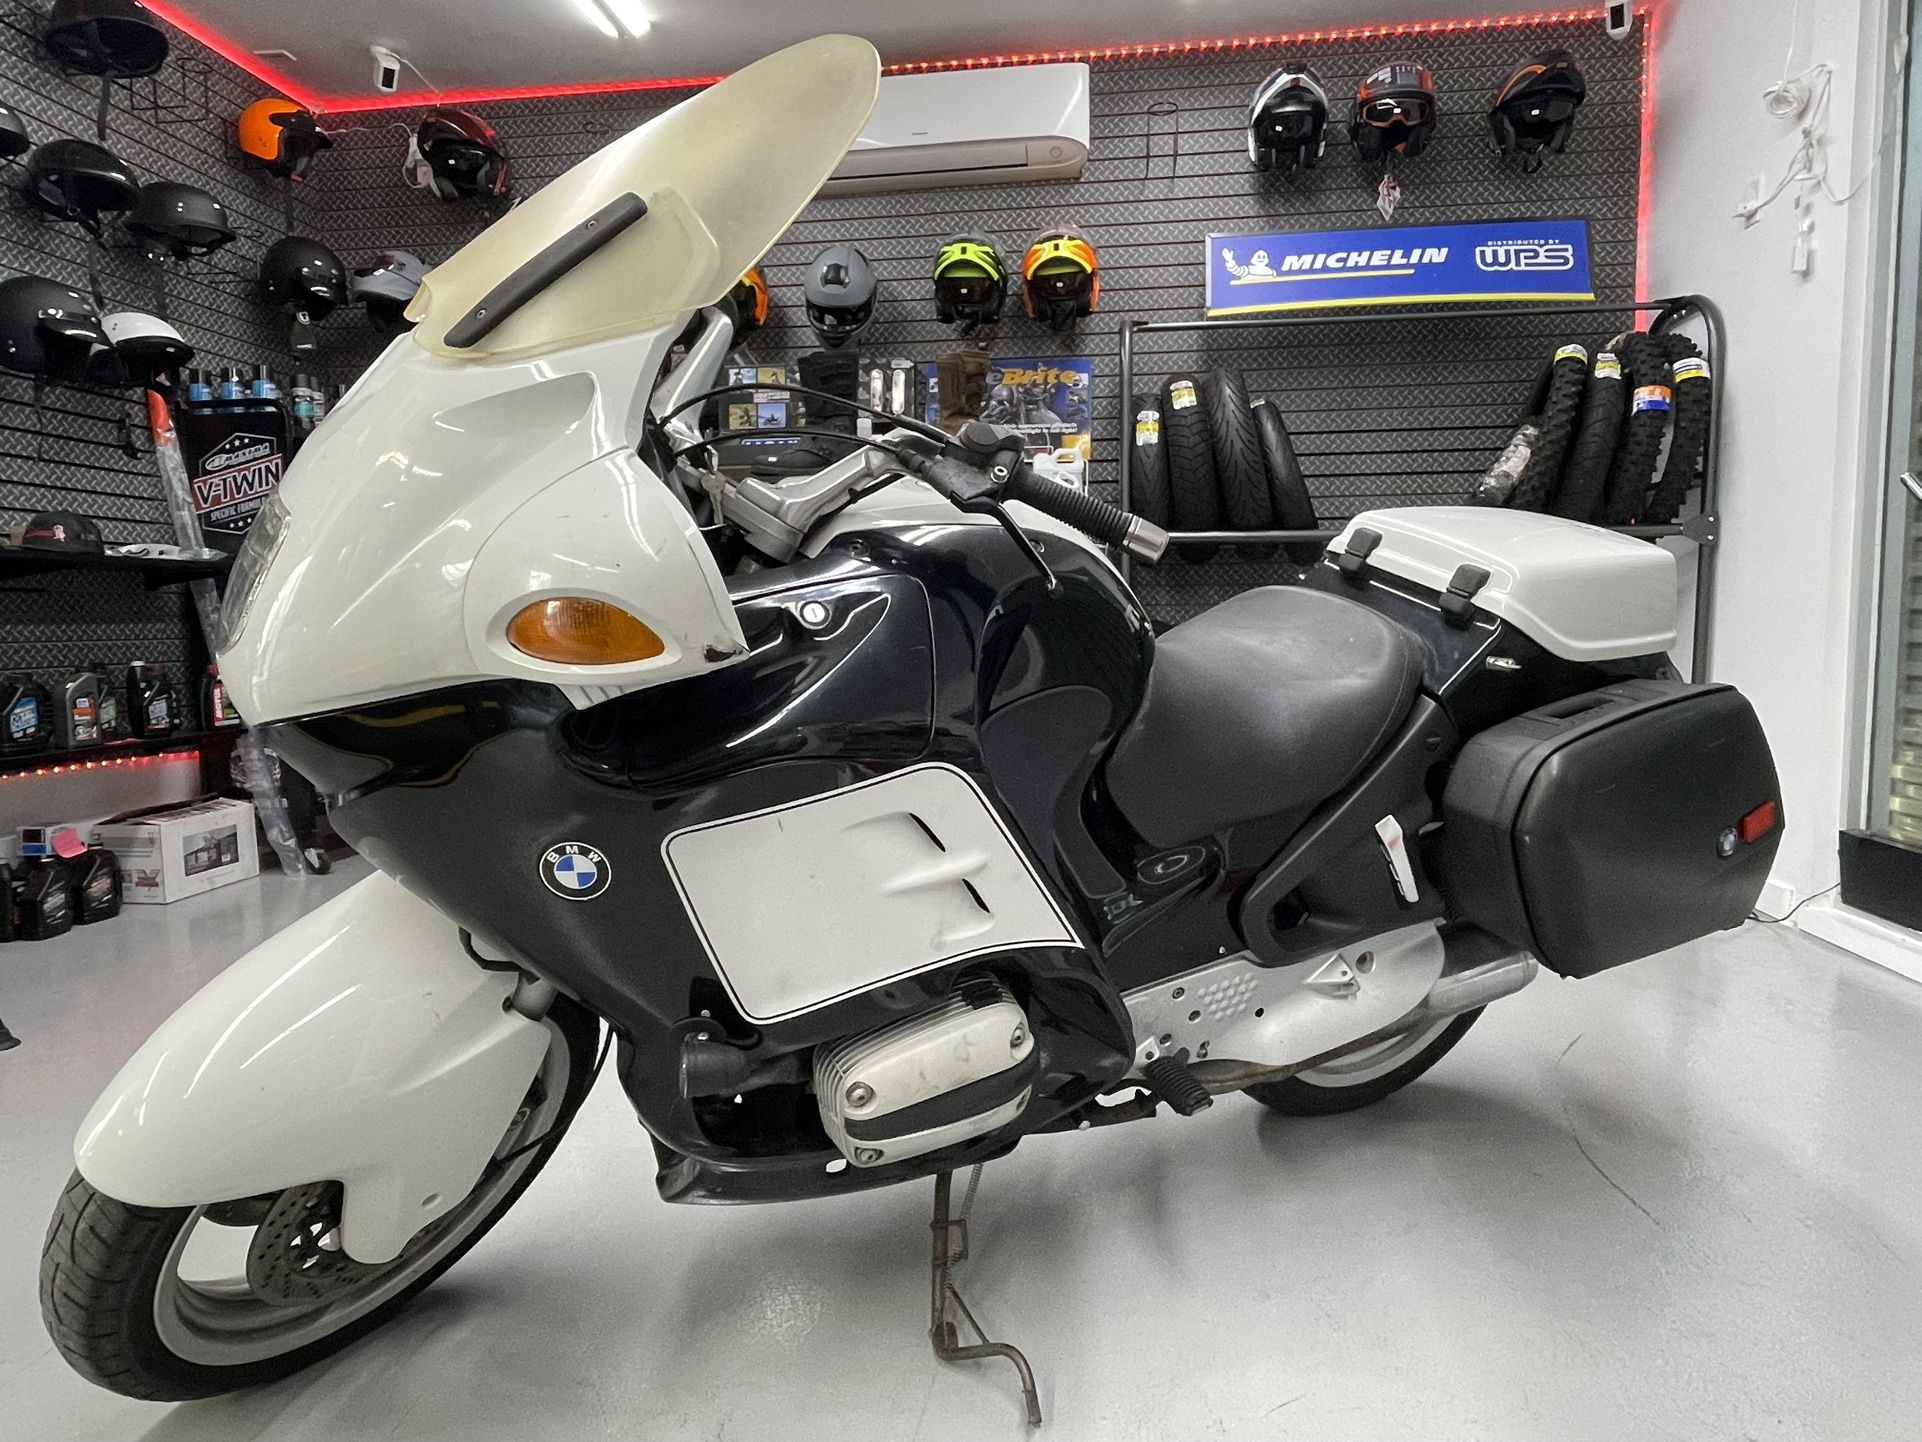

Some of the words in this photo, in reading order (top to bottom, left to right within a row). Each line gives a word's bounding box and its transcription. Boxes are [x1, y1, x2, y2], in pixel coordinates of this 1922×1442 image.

[1281, 247, 1449, 272] MICHELIN
[1475, 244, 1574, 271] WPS
[194, 458, 282, 508] V-TWIN
[214, 688, 223, 718] MOTUL
[546, 845, 602, 863] BMW
